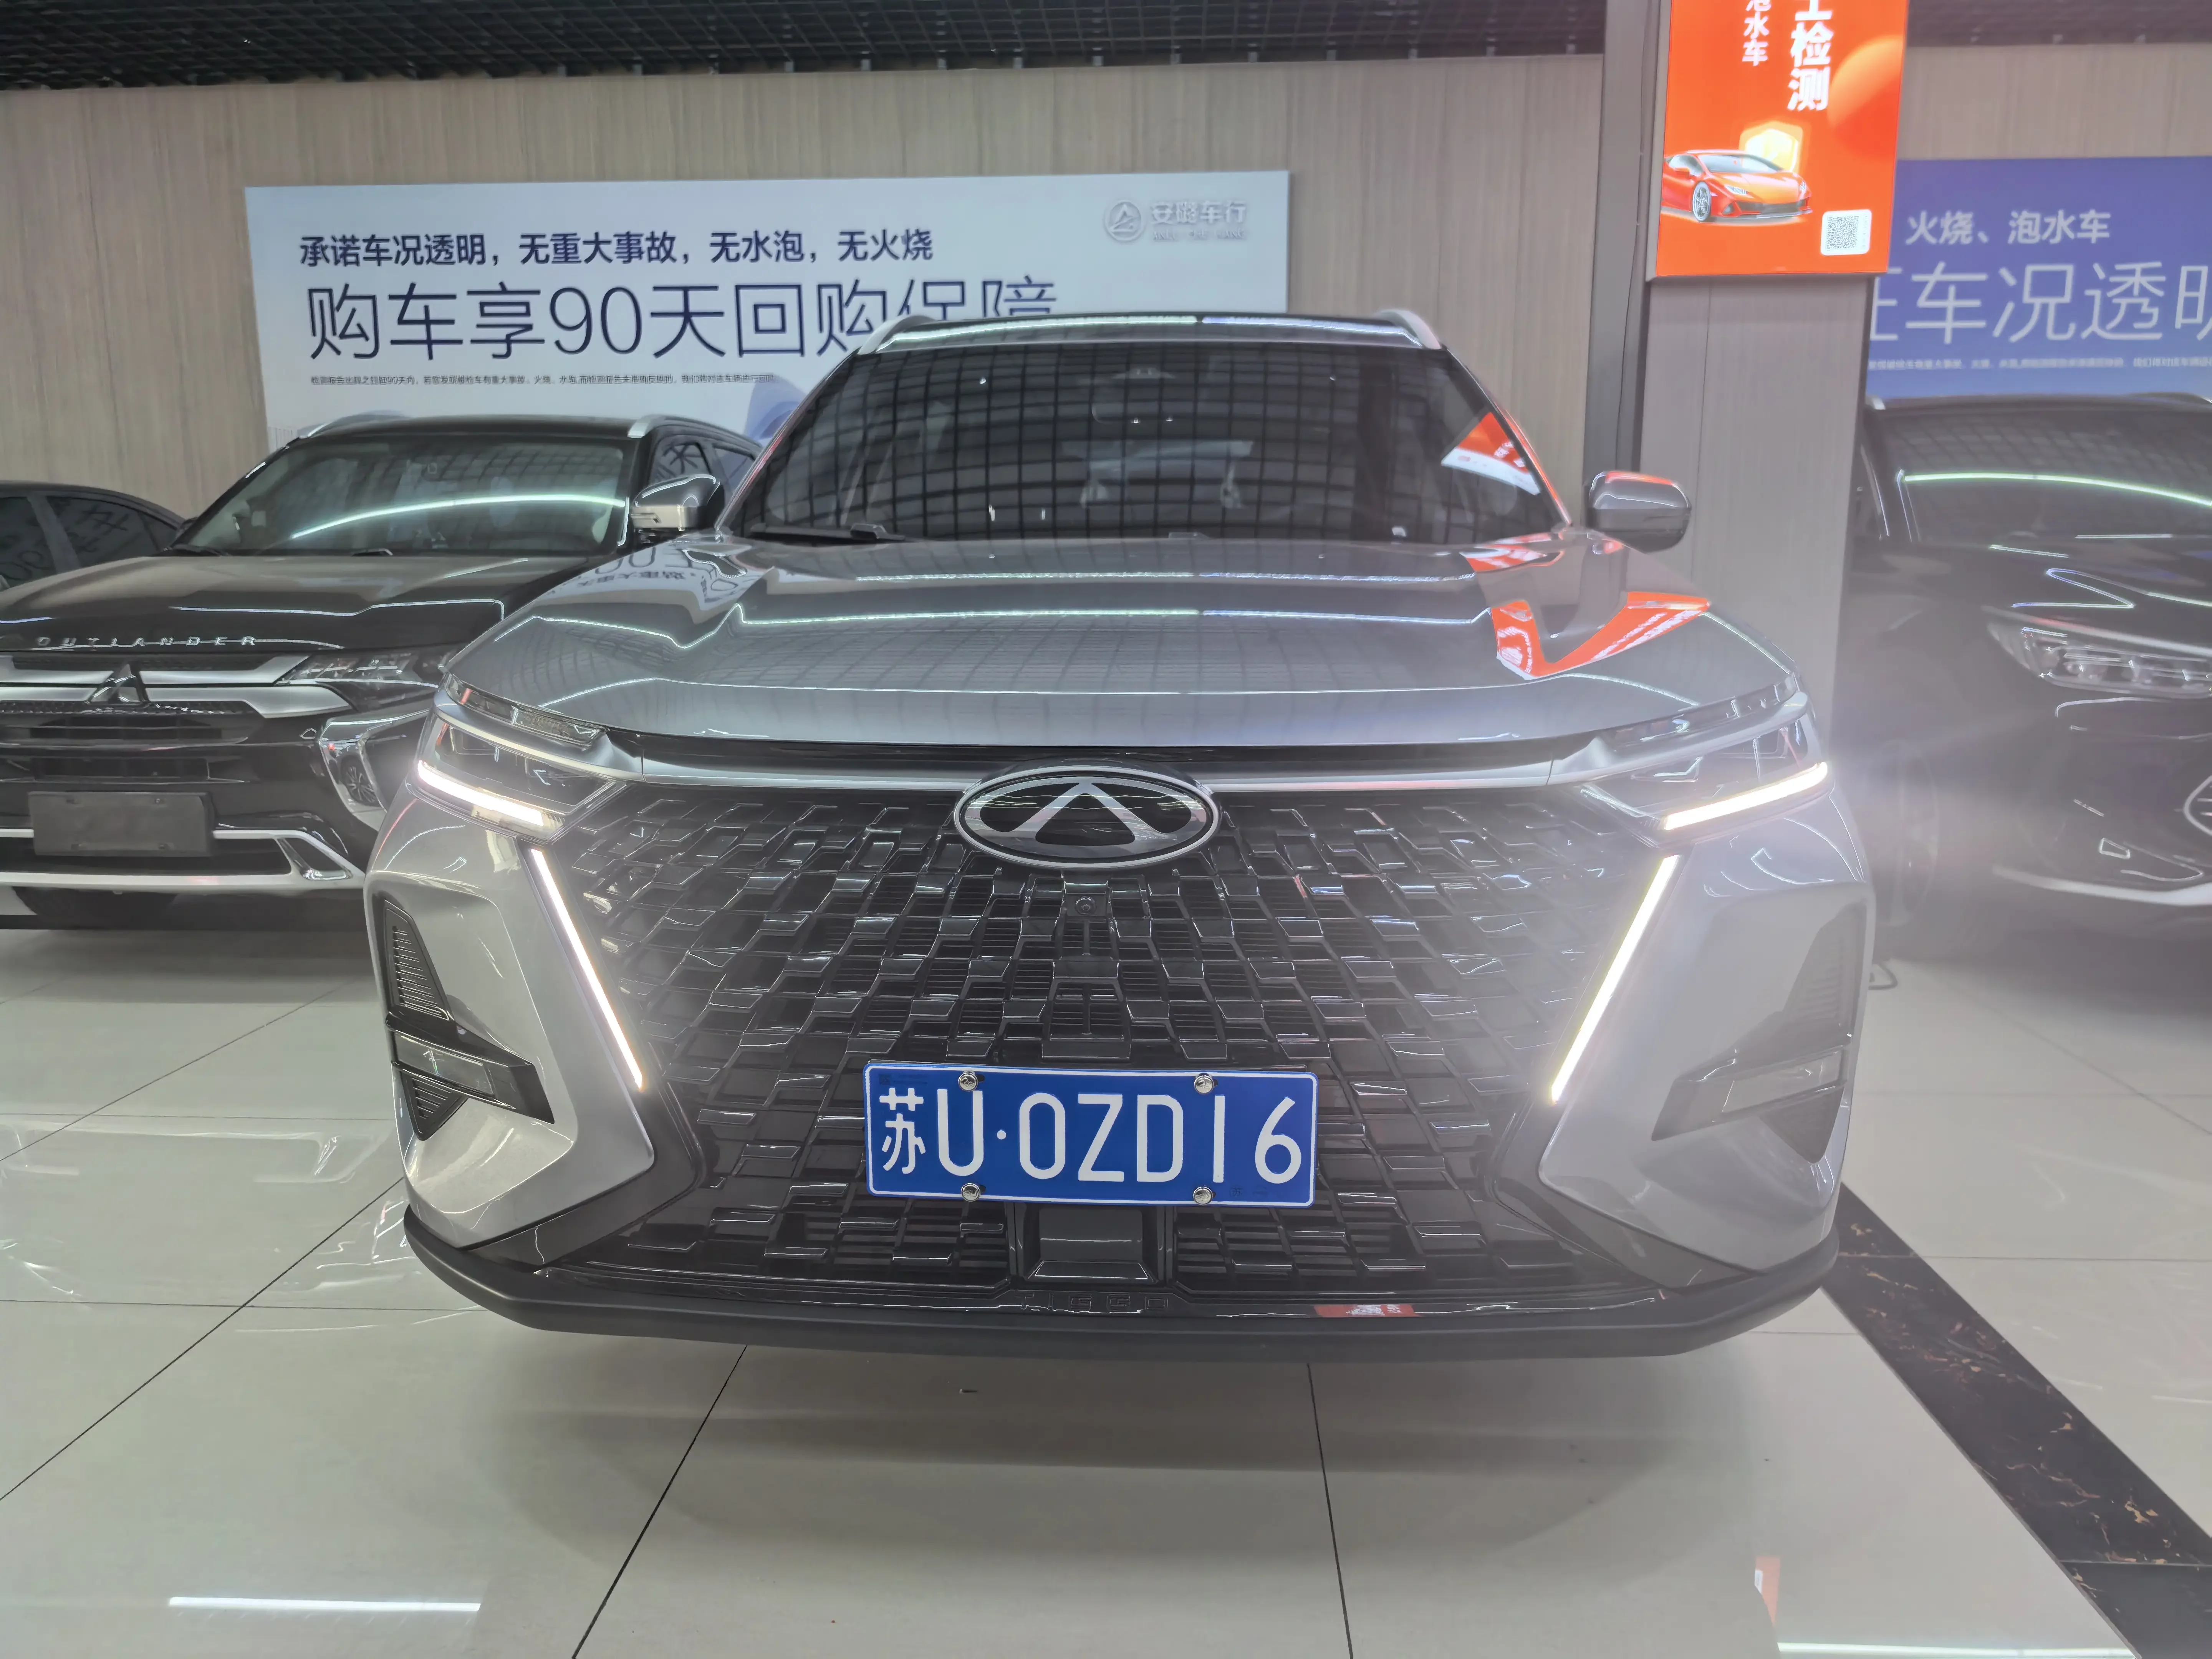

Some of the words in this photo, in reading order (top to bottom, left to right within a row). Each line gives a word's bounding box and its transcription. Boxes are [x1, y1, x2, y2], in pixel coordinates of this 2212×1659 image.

[1905, 209, 2111, 245] 火烧、泡水车
[37, 636, 256, 650] OUTLANDER
[1015, 1291, 1169, 1312] TIGGO
